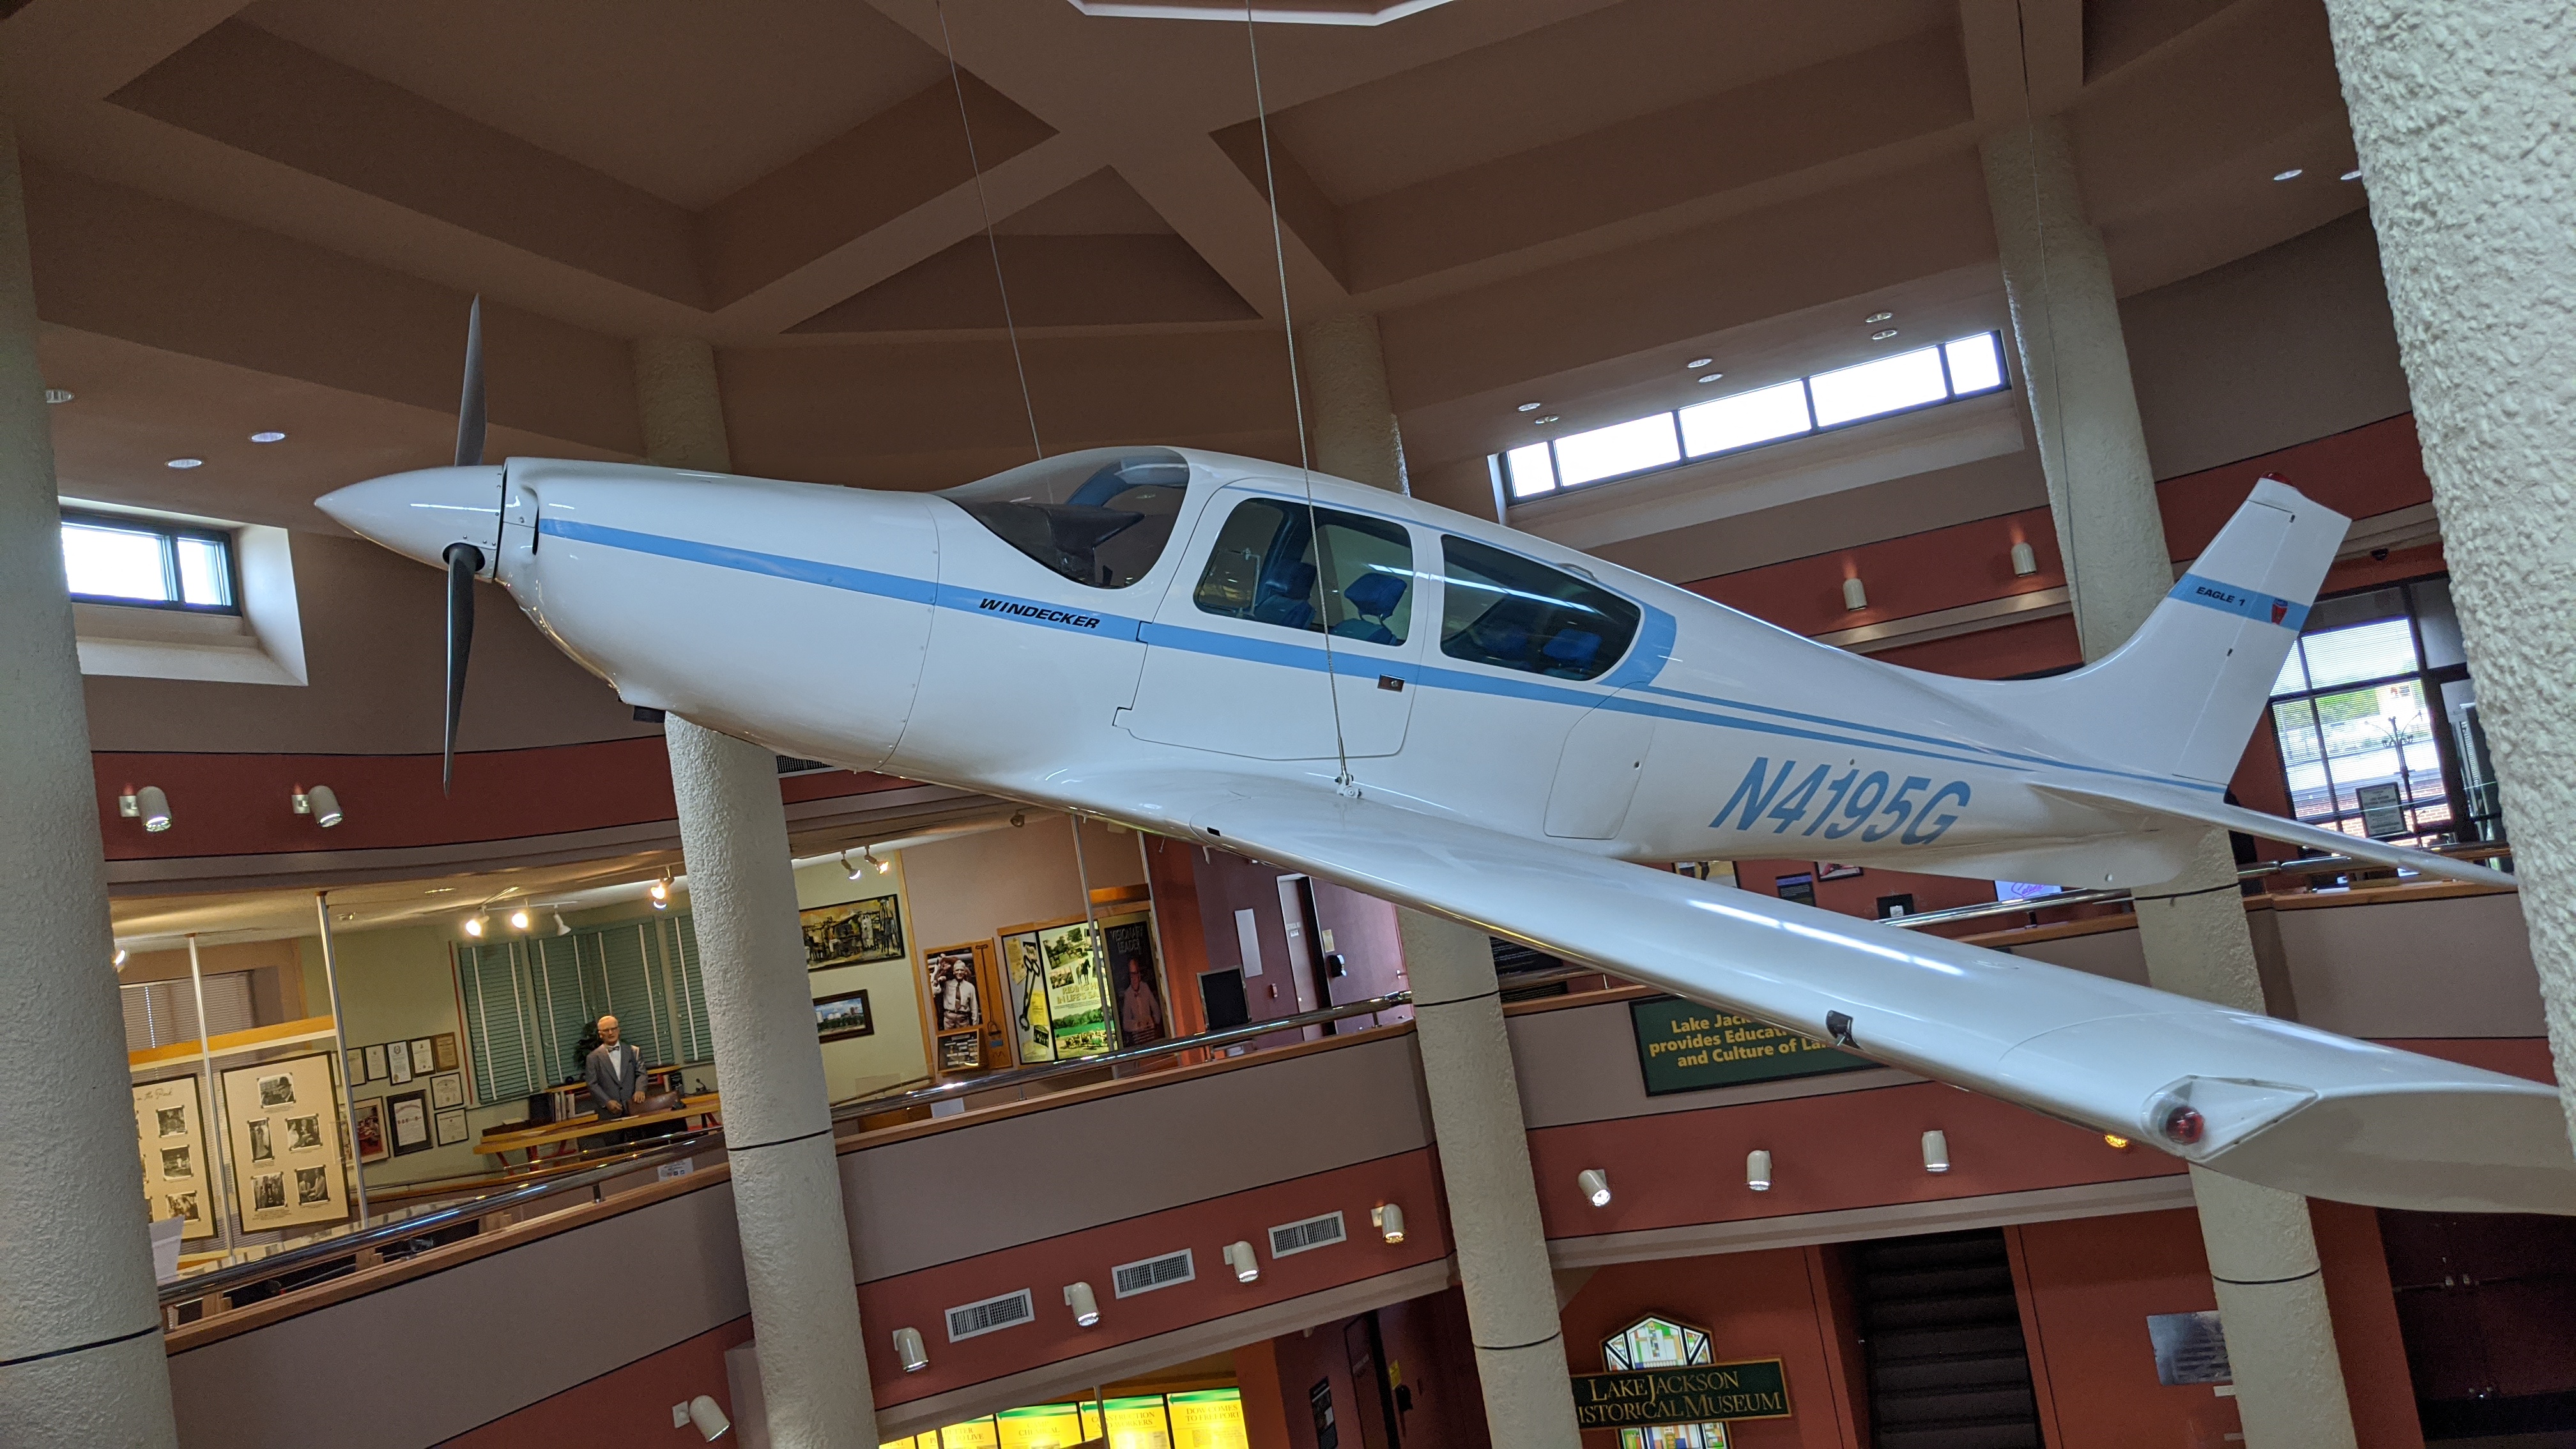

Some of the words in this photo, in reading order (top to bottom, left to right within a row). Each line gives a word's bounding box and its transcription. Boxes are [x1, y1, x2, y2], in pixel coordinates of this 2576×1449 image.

[2196, 586, 2235, 603] EAGLE
[979, 598, 1100, 629] WINDECKER
[1708, 756, 1971, 845] N4195G
[1062, 984, 1089, 995] RIDING
[1057, 996, 1066, 1004] IN
[1671, 1016, 1710, 1034] Lake
[1714, 1014, 1751, 1028] Jac
[1648, 1033, 1721, 1057] provides
[1724, 1027, 1787, 1044] Educat
[1677, 1050, 1708, 1068] and
[1712, 1045, 1774, 1062] Culture
[1778, 1038, 1797, 1054] of
[1801, 1037, 1827, 1051] La
[1588, 1377, 1648, 1402] LAKE
[1647, 1371, 1740, 1403] JACKSON
[1186, 1407, 1207, 1415] DOW
[1208, 1404, 1238, 1413] COMES
[1199, 1411, 1241, 1420] FREEPORT
[1579, 1399, 1684, 1424] ISTORICAL
[1683, 1392, 1782, 1418] MUSEUM
[1018, 1427, 1061, 1436] CHEMICAL
[1114, 1419, 1153, 1428] WORKERS
